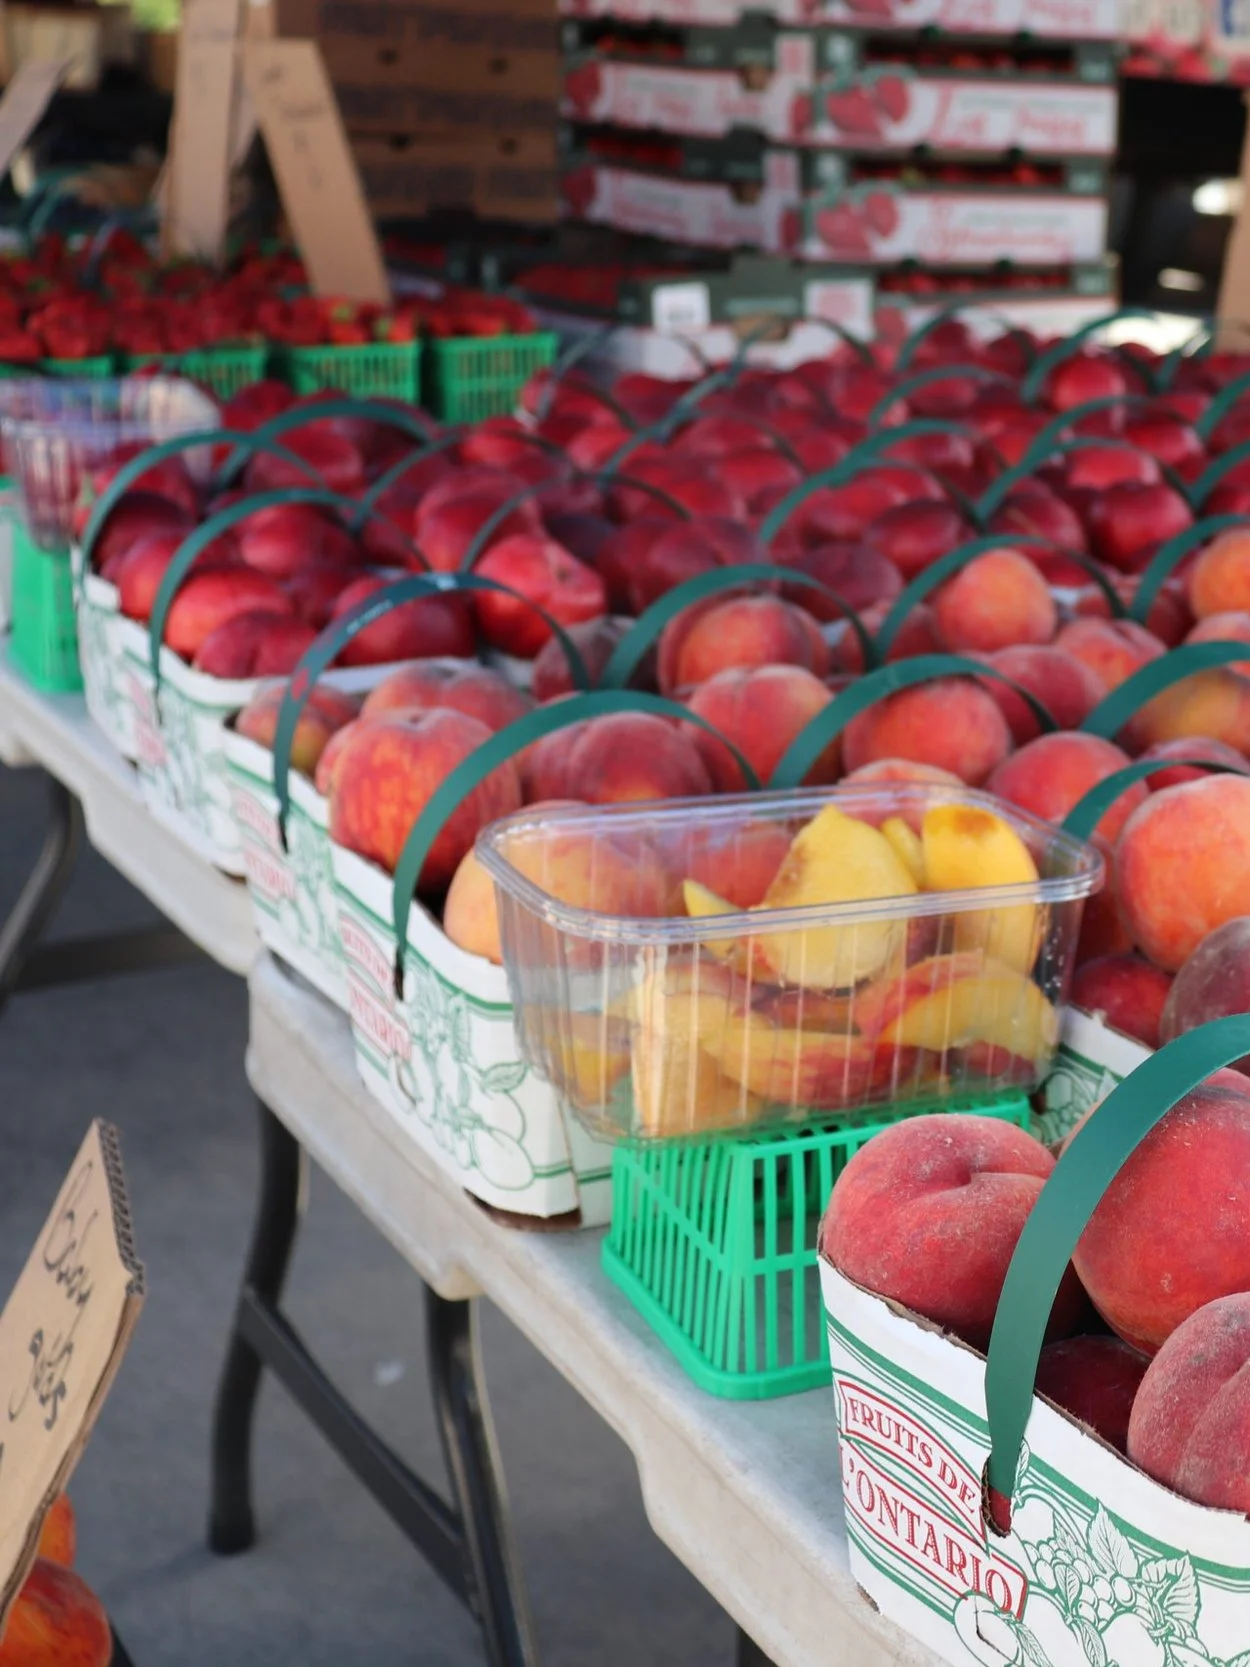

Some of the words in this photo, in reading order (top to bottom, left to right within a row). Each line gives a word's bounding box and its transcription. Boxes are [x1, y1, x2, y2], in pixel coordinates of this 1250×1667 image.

[847, 1396, 934, 1470] FRUITS
[937, 1458, 977, 1514] DE
[837, 1446, 1013, 1613] L'ONTARIO
